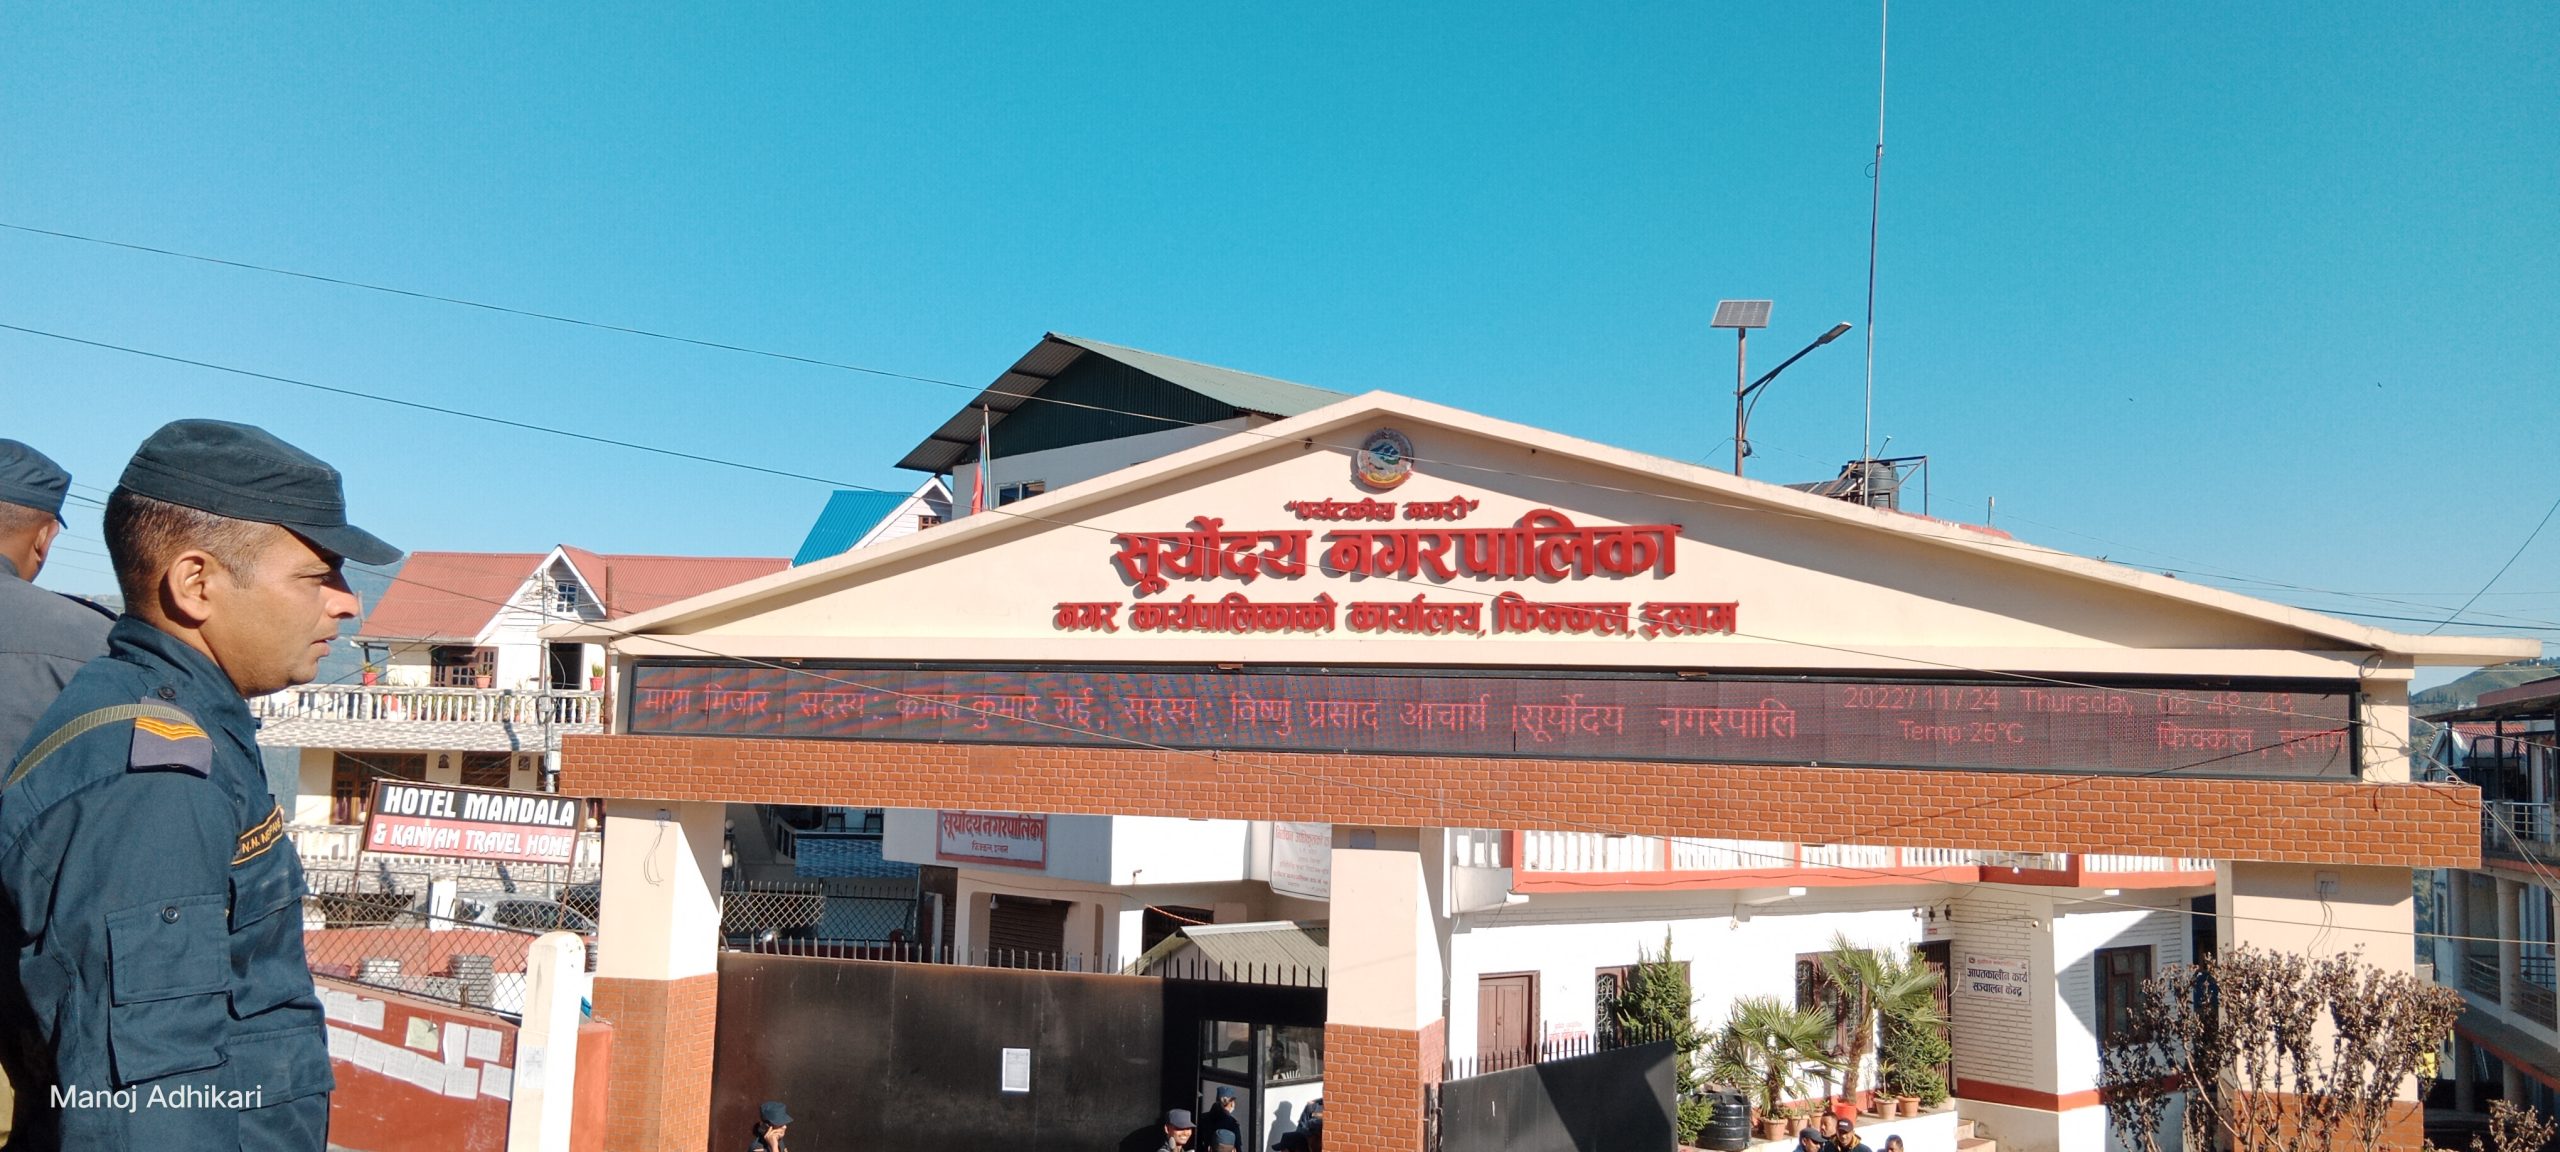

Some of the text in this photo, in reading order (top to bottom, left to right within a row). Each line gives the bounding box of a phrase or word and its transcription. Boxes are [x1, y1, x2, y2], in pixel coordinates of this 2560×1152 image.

[1115, 509, 1681, 593] सूर्योदय नगरपालिका
[1056, 601, 1122, 632] नगर
[1132, 592, 1338, 633] कार्यपालिकाको
[1644, 600, 1739, 637] इलाम
[971, 694, 1041, 730] कुमार
[1229, 690, 1292, 736] विष्णु
[1305, 700, 1381, 731] प्रसाद
[1399, 693, 1490, 731] आचार्य
[1656, 697, 1797, 738] नगरपालि
[383, 785, 575, 827] HOTEL MANDALA
[942, 810, 1043, 842] सूर्योदय नगरपालिका
[373, 822, 573, 857] & KANYAM TRAVEL HOME
[2012, 971, 2028, 983] कार्य
